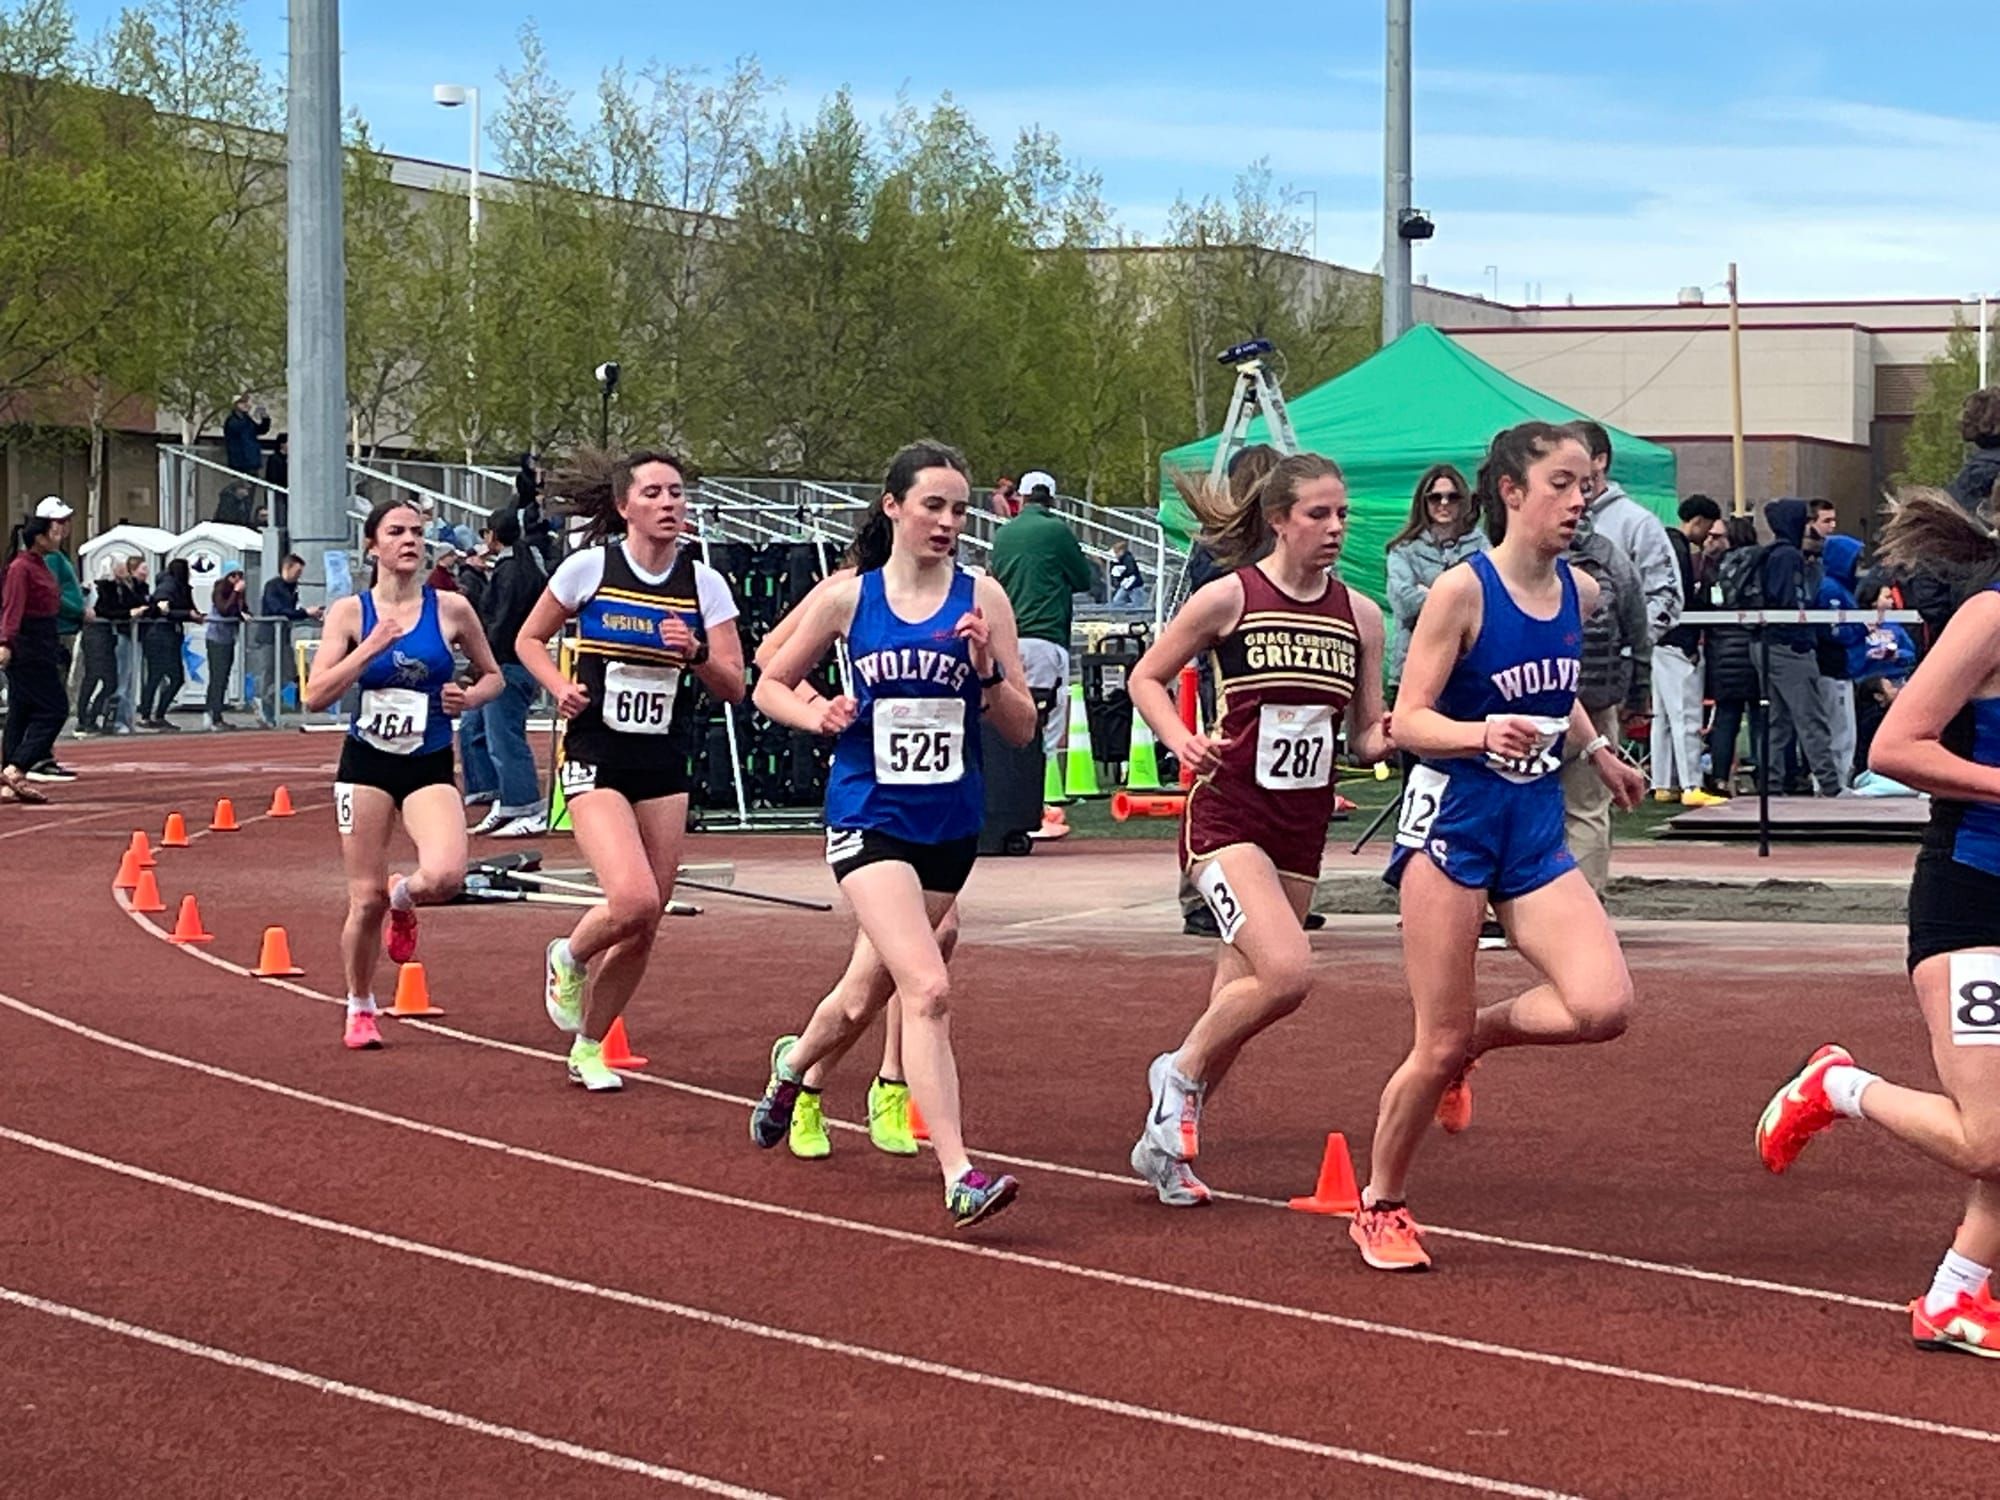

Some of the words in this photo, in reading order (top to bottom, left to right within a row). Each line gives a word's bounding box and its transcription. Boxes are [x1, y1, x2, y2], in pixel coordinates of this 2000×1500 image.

[1244, 632, 1291, 646] GRACE
[854, 649, 970, 692] WOLVES
[1246, 645, 1356, 678] GRIZZLIES
[366, 713, 414, 740] 464
[616, 690, 666, 725] 605
[889, 731, 951, 772] 525
[1269, 736, 1324, 778] 287
[1401, 788, 1437, 832] 12
[1214, 882, 1236, 919] 3
[1957, 980, 2000, 1026] 8
